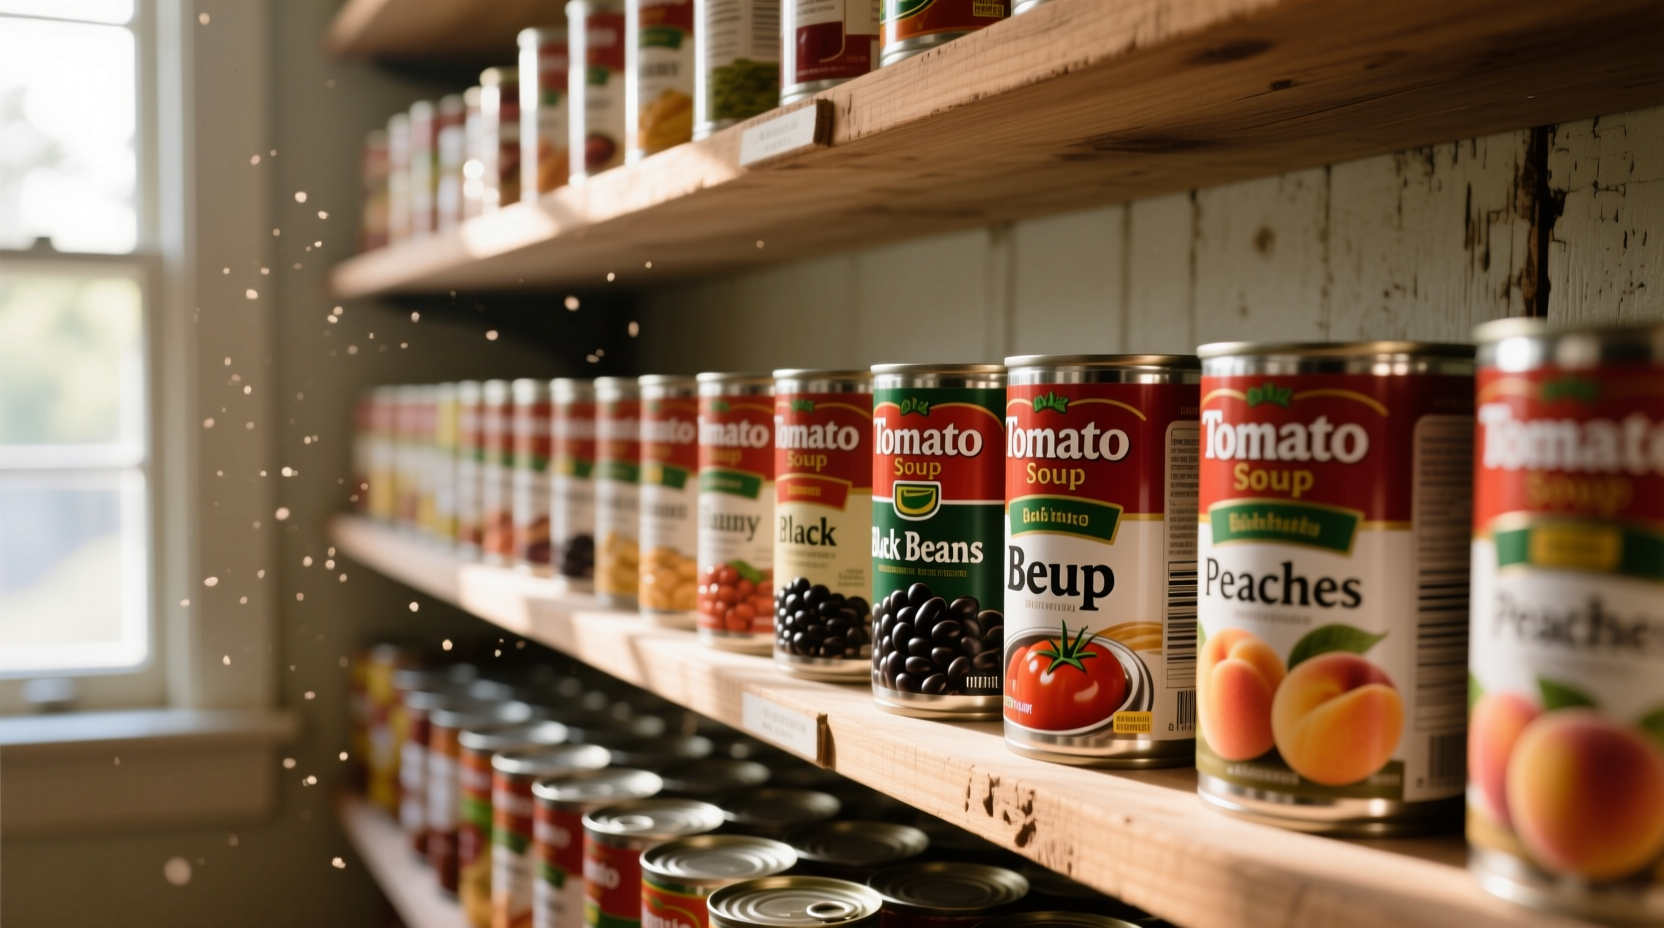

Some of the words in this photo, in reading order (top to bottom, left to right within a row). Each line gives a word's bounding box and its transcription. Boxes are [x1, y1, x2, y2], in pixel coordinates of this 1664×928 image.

[774, 415, 860, 451] Tomato
[873, 416, 983, 457] Tomato
[1006, 416, 1130, 461] Tomato
[1202, 409, 1370, 464] Tomato
[787, 450, 828, 472] Soup
[894, 457, 942, 480] Soup
[1026, 462, 1086, 490] Soup
[1233, 462, 1315, 498] Soup
[780, 515, 837, 547] Black
[905, 531, 984, 564] Beans
[1007, 545, 1116, 611] Beup
[1206, 557, 1364, 609] Peaches
